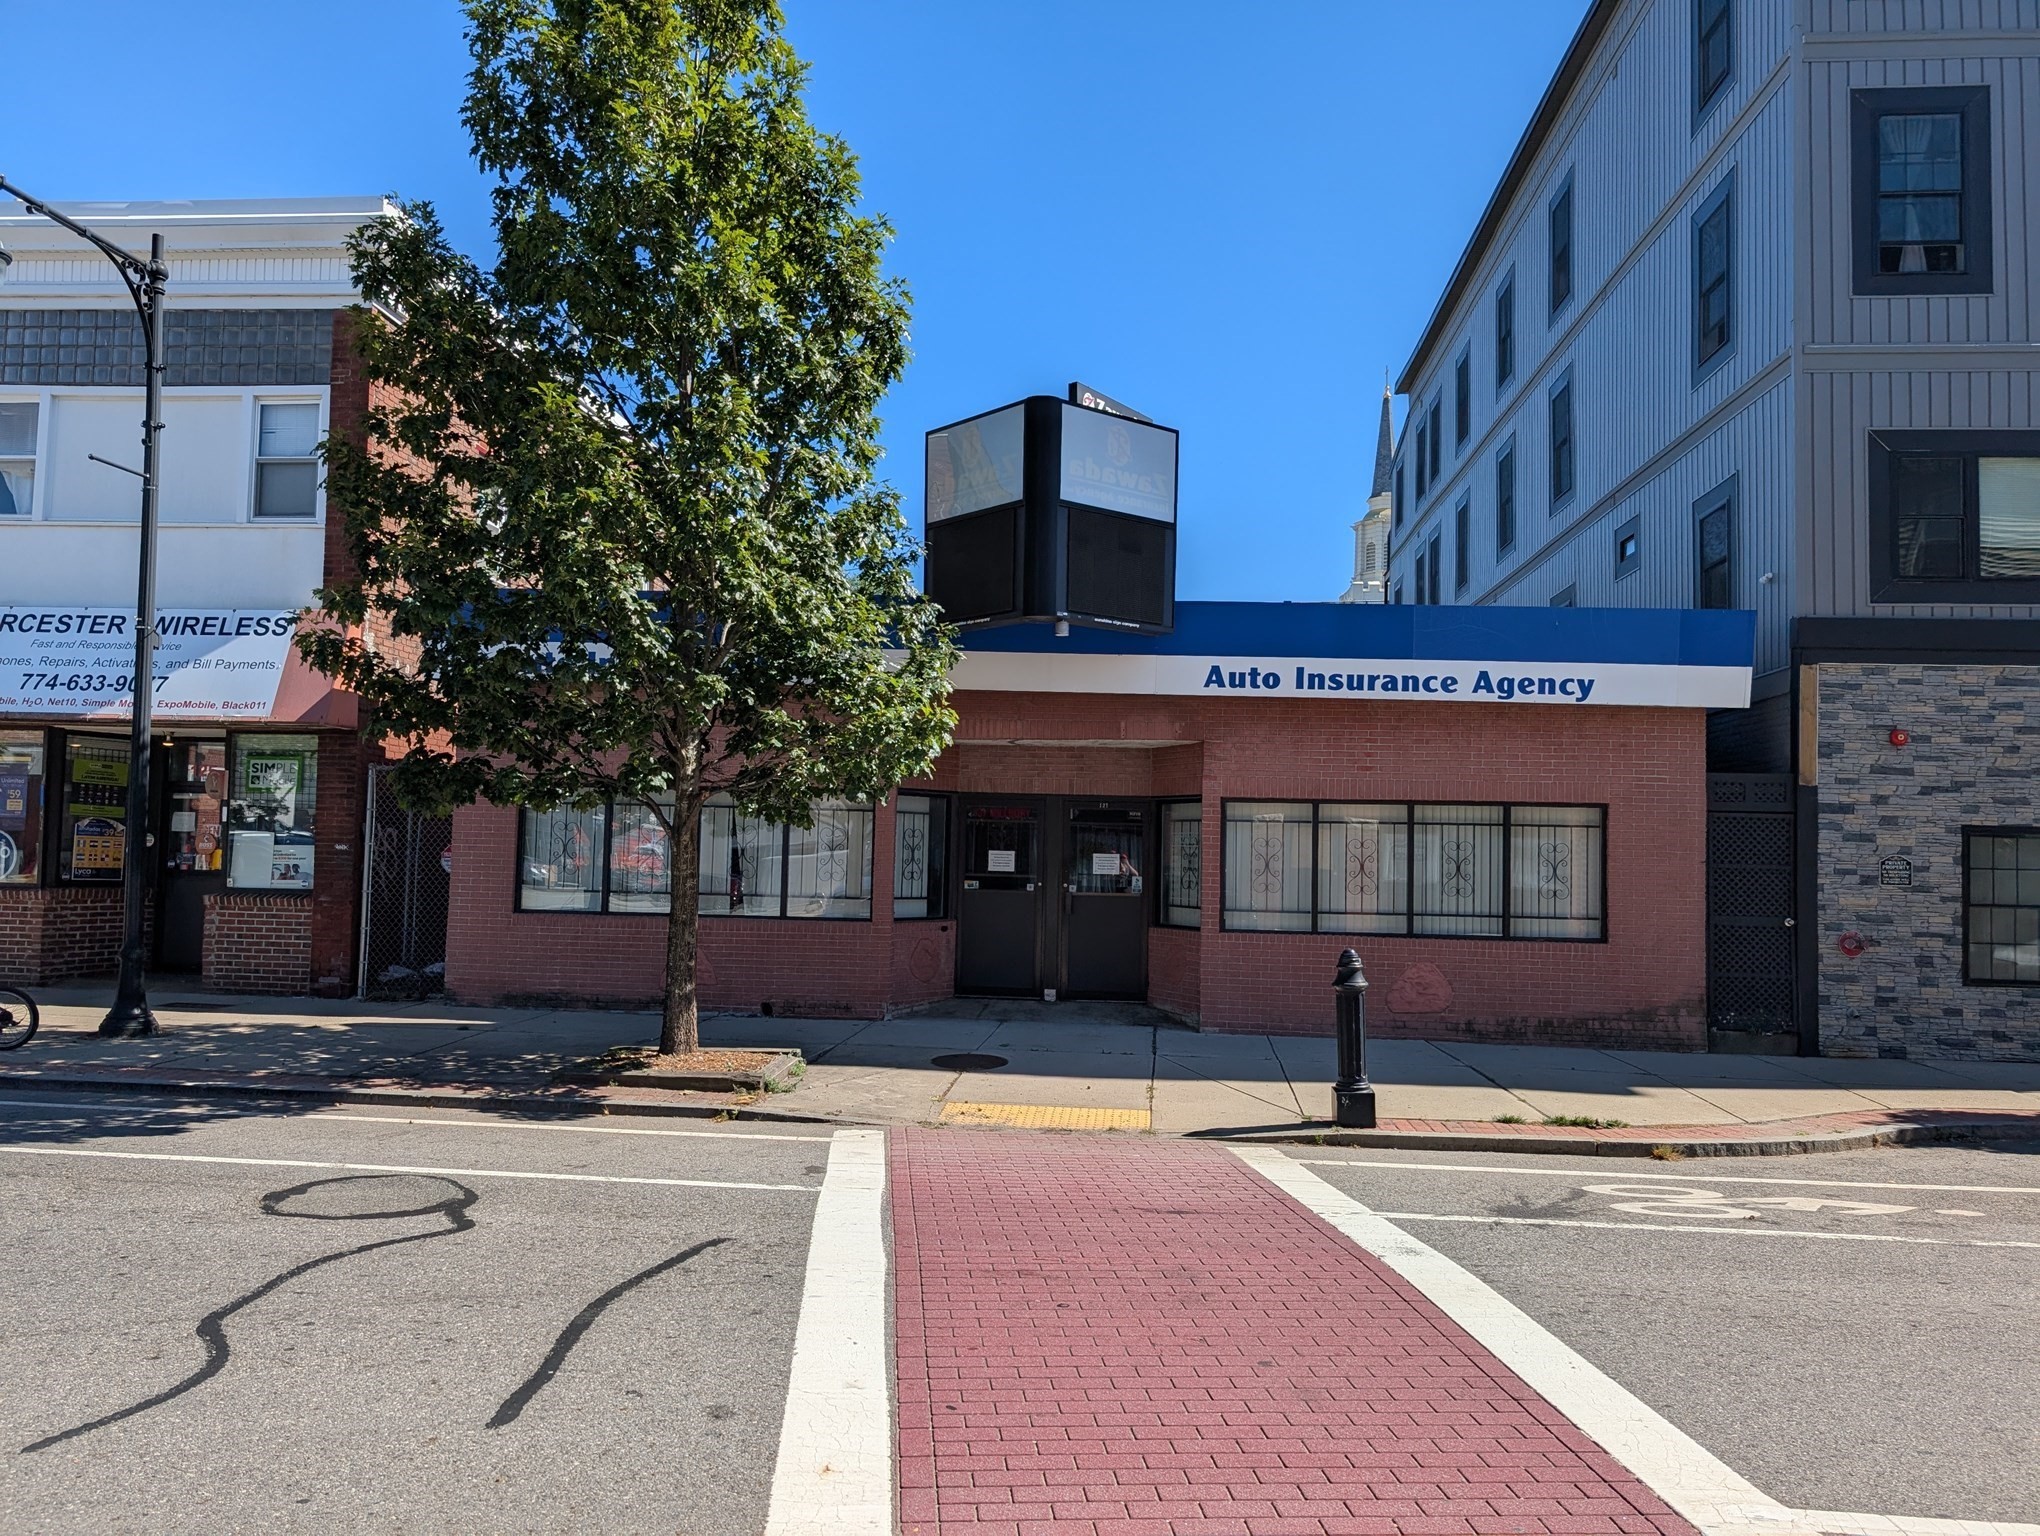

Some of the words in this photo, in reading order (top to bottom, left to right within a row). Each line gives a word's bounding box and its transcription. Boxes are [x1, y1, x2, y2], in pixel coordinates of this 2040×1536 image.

[0, 613, 127, 634] RCESTER
[30, 639, 55, 649] Fast
[55, 640, 77, 650] and
[0, 656, 34, 668] ones,
[39, 655, 88, 669] Repairs,
[91, 657, 161, 670] Activats,
[165, 659, 190, 669] and
[192, 659, 212, 670] Bill
[1204, 665, 1281, 690] Auto
[1295, 666, 1458, 694] Insurance
[1472, 670, 1595, 703] Agency
[47, 698, 78, 708] Net10,
[81, 698, 116, 709] Simple
[157, 699, 219, 710] ExpoMobile,
[221, 701, 267, 710] Black011
[251, 762, 297, 774] SIMPLE
[74, 868, 92, 876] Lyca
